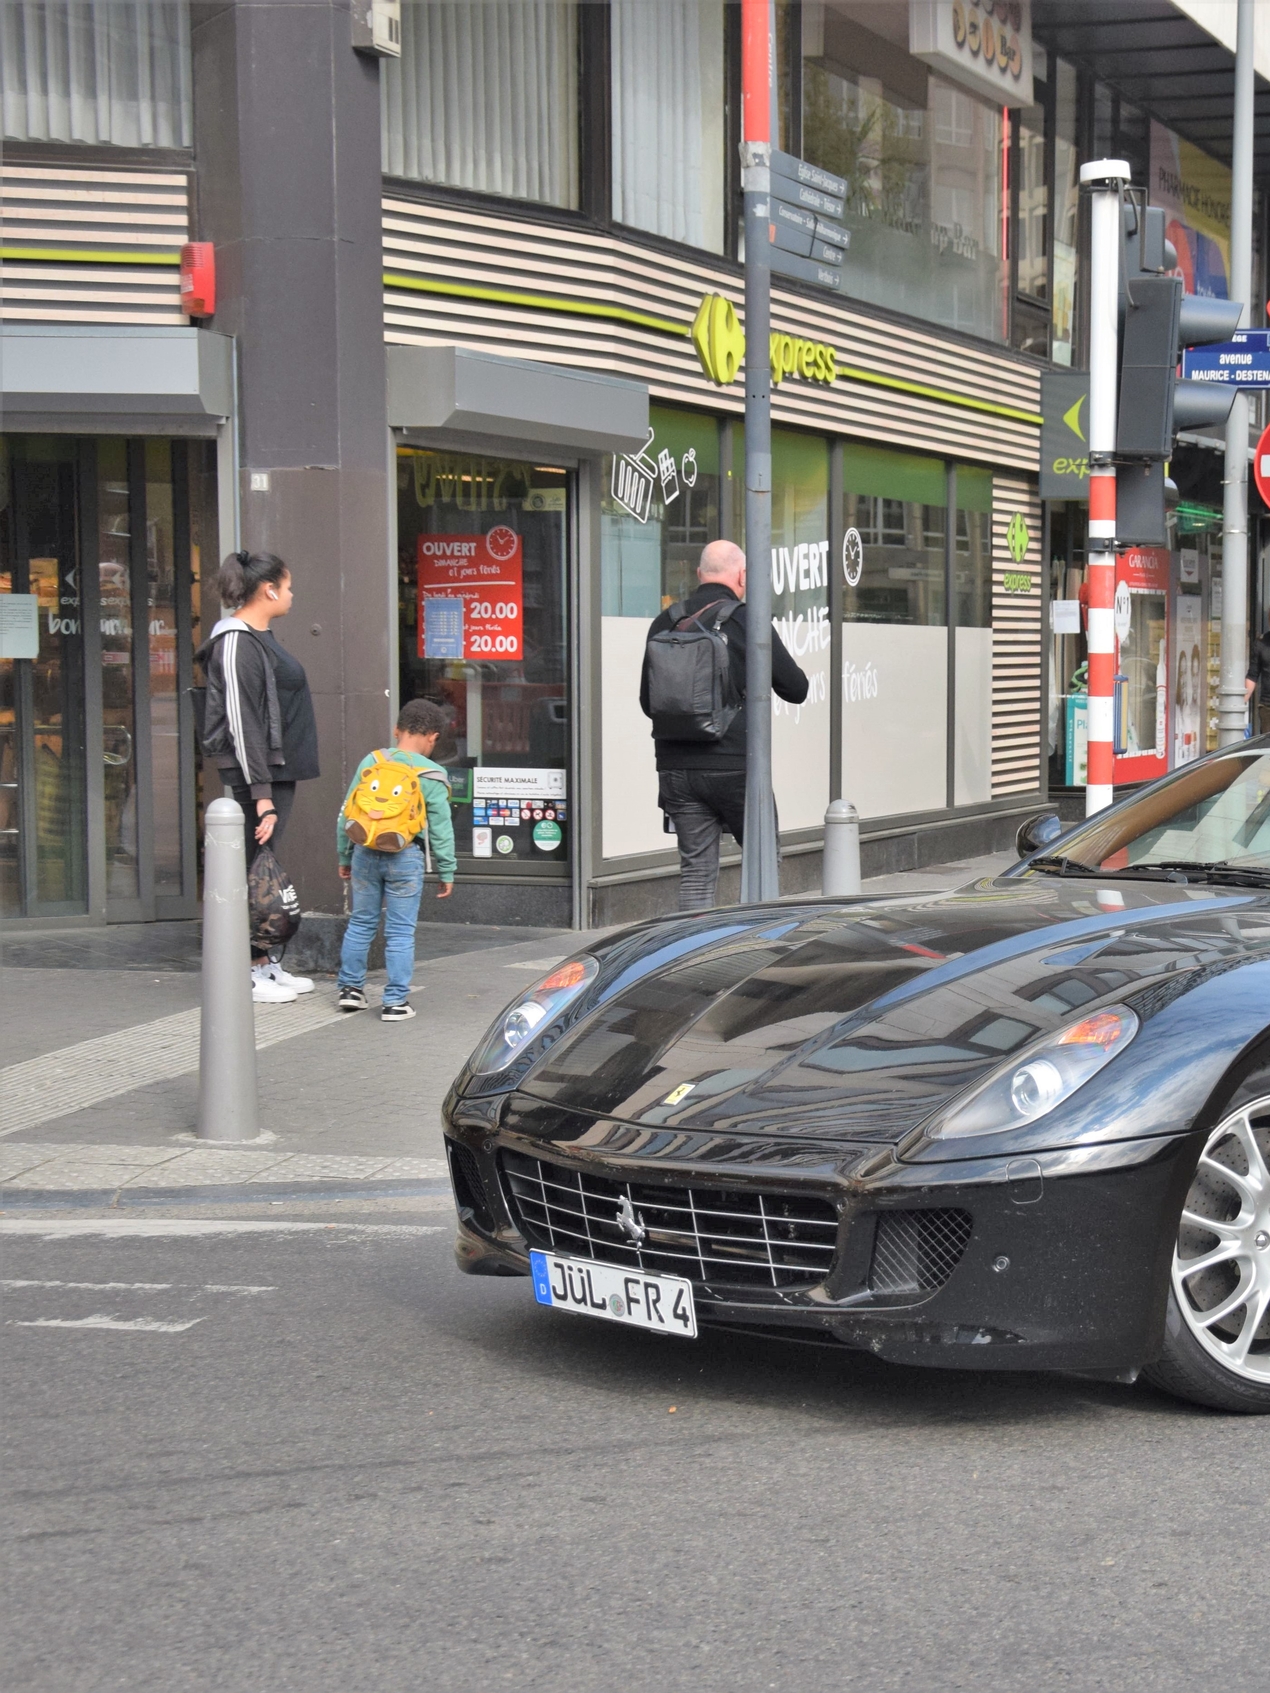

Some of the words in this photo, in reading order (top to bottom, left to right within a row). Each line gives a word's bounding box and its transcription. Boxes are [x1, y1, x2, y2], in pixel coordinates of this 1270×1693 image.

[770, 332, 837, 384] xpress
[1219, 353, 1253, 365] avenue
[1191, 370, 1230, 381] MAURICE
[254, 475, 267, 489] 31
[422, 542, 477, 556] OUVERT
[433, 558, 469, 567] DIMANCHE
[770, 540, 829, 596] UVERT
[460, 568, 478, 579] jours
[479, 564, 501, 575] fériés
[1003, 572, 1032, 596] express
[470, 602, 518, 619] 20.00
[470, 635, 518, 652] 20.00
[842, 660, 878, 704] fériés
[540, 1283, 547, 1295] D
[552, 1261, 607, 1311] JÜL
[624, 1276, 666, 1324] FR
[673, 1287, 690, 1329] 4
